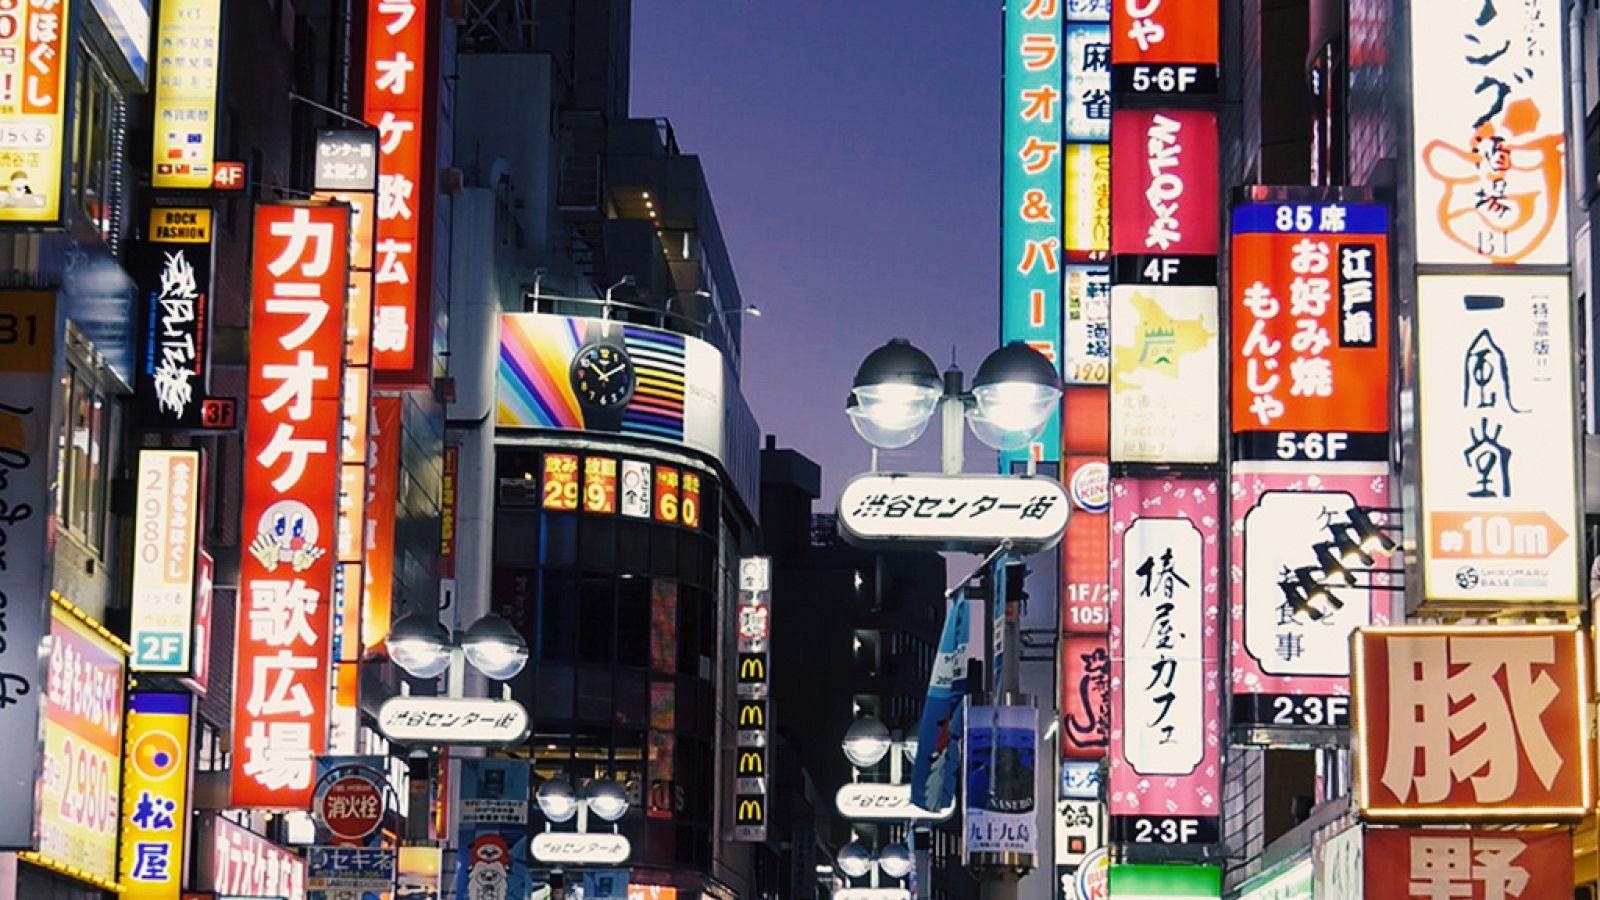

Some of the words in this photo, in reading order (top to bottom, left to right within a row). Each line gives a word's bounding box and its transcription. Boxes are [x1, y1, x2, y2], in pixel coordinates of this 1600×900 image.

[214, 166, 242, 186] 4F
[156, 228, 204, 240] FASHION
[1143, 258, 1181, 283] 4F
[1289, 238, 1334, 397] お好み焼
[256, 208, 334, 493] カラオケ
[1242, 281, 1285, 426] もんじゃ
[206, 402, 231, 425] 3F
[1463, 294, 1533, 498] 一風堂
[852, 493, 1057, 520] 渋谷センター街
[1070, 606, 1109, 624] 105
[1136, 547, 1190, 745] 椿屋カフェ
[141, 636, 180, 660] 2F
[243, 579, 321, 792] 歌広場
[1380, 635, 1564, 805] 豚
[131, 792, 175, 881] 松屋
[327, 796, 379, 819] 消火栓
[1408, 836, 1531, 900] 野
